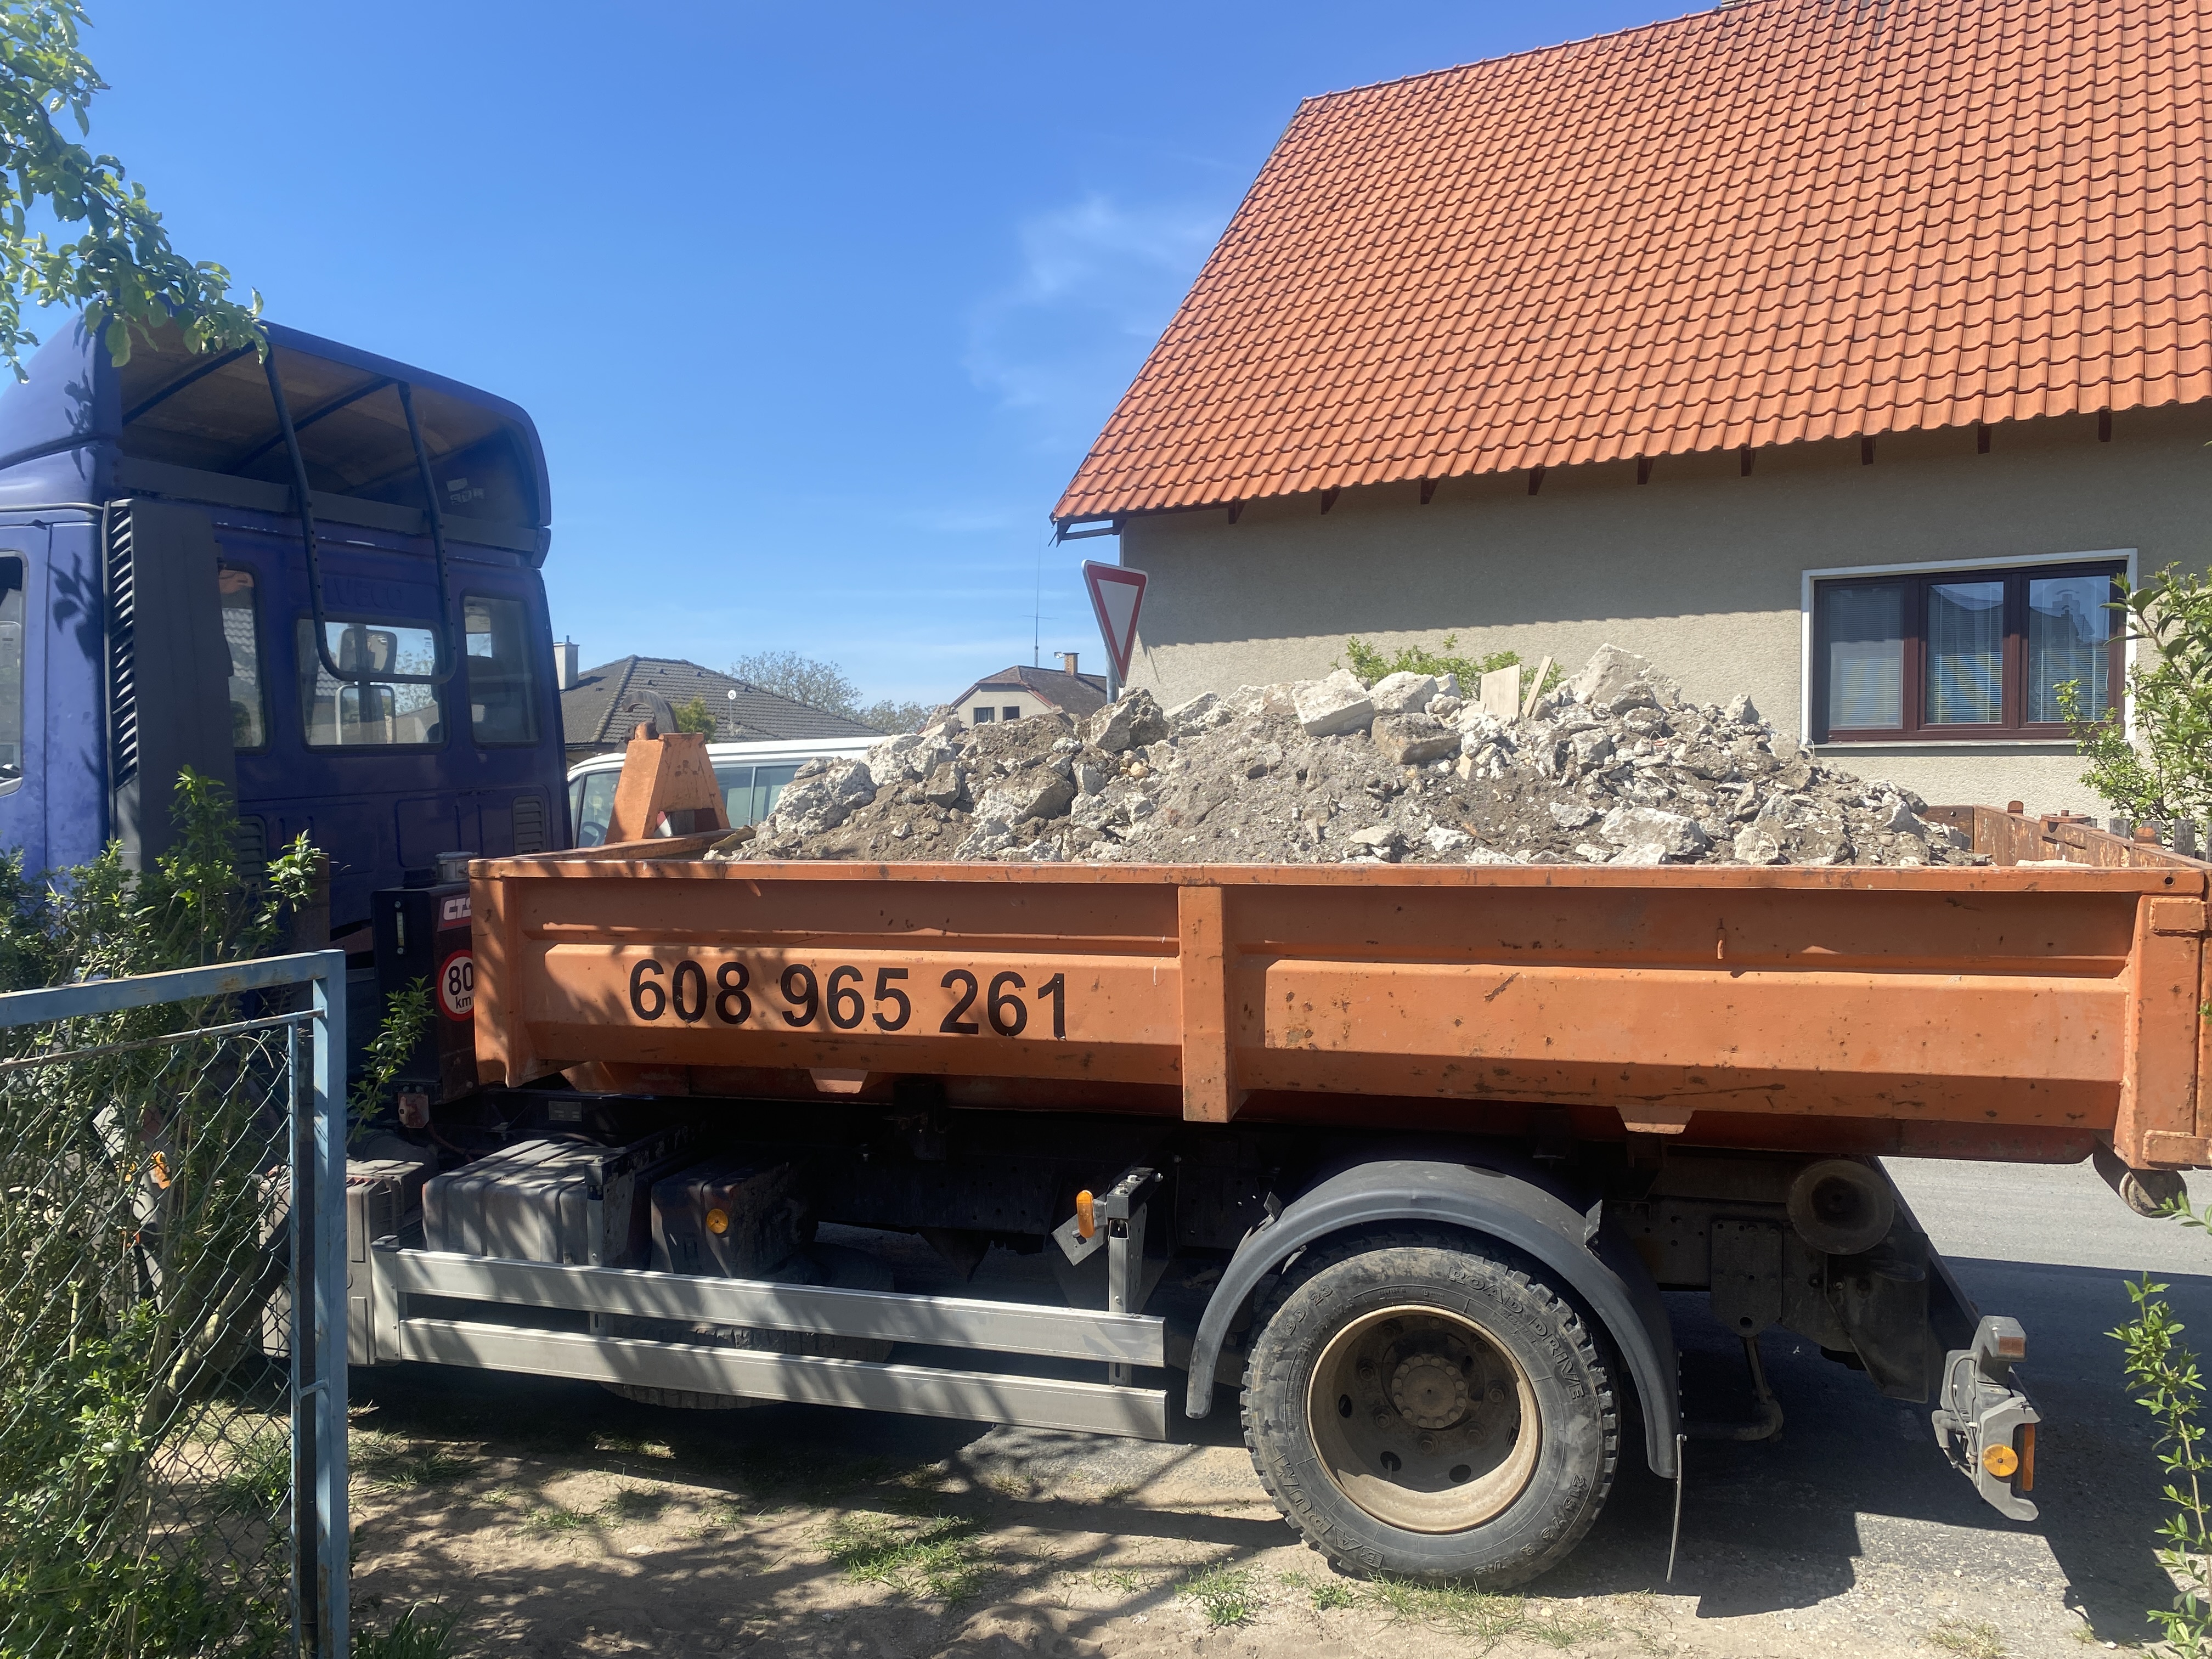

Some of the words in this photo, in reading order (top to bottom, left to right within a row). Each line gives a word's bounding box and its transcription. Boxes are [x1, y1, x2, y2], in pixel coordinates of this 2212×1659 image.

[448, 962, 473, 996] 80
[455, 996, 471, 1008] km
[629, 959, 752, 1025] 608
[780, 963, 911, 1032] 965
[939, 969, 1066, 1041] 261
[1310, 1284, 1334, 1306] 23
[1447, 1267, 1523, 1313] ROAD
[1528, 1317, 1585, 1400] DRIVE
[1272, 1453, 1385, 1568] BARUM
